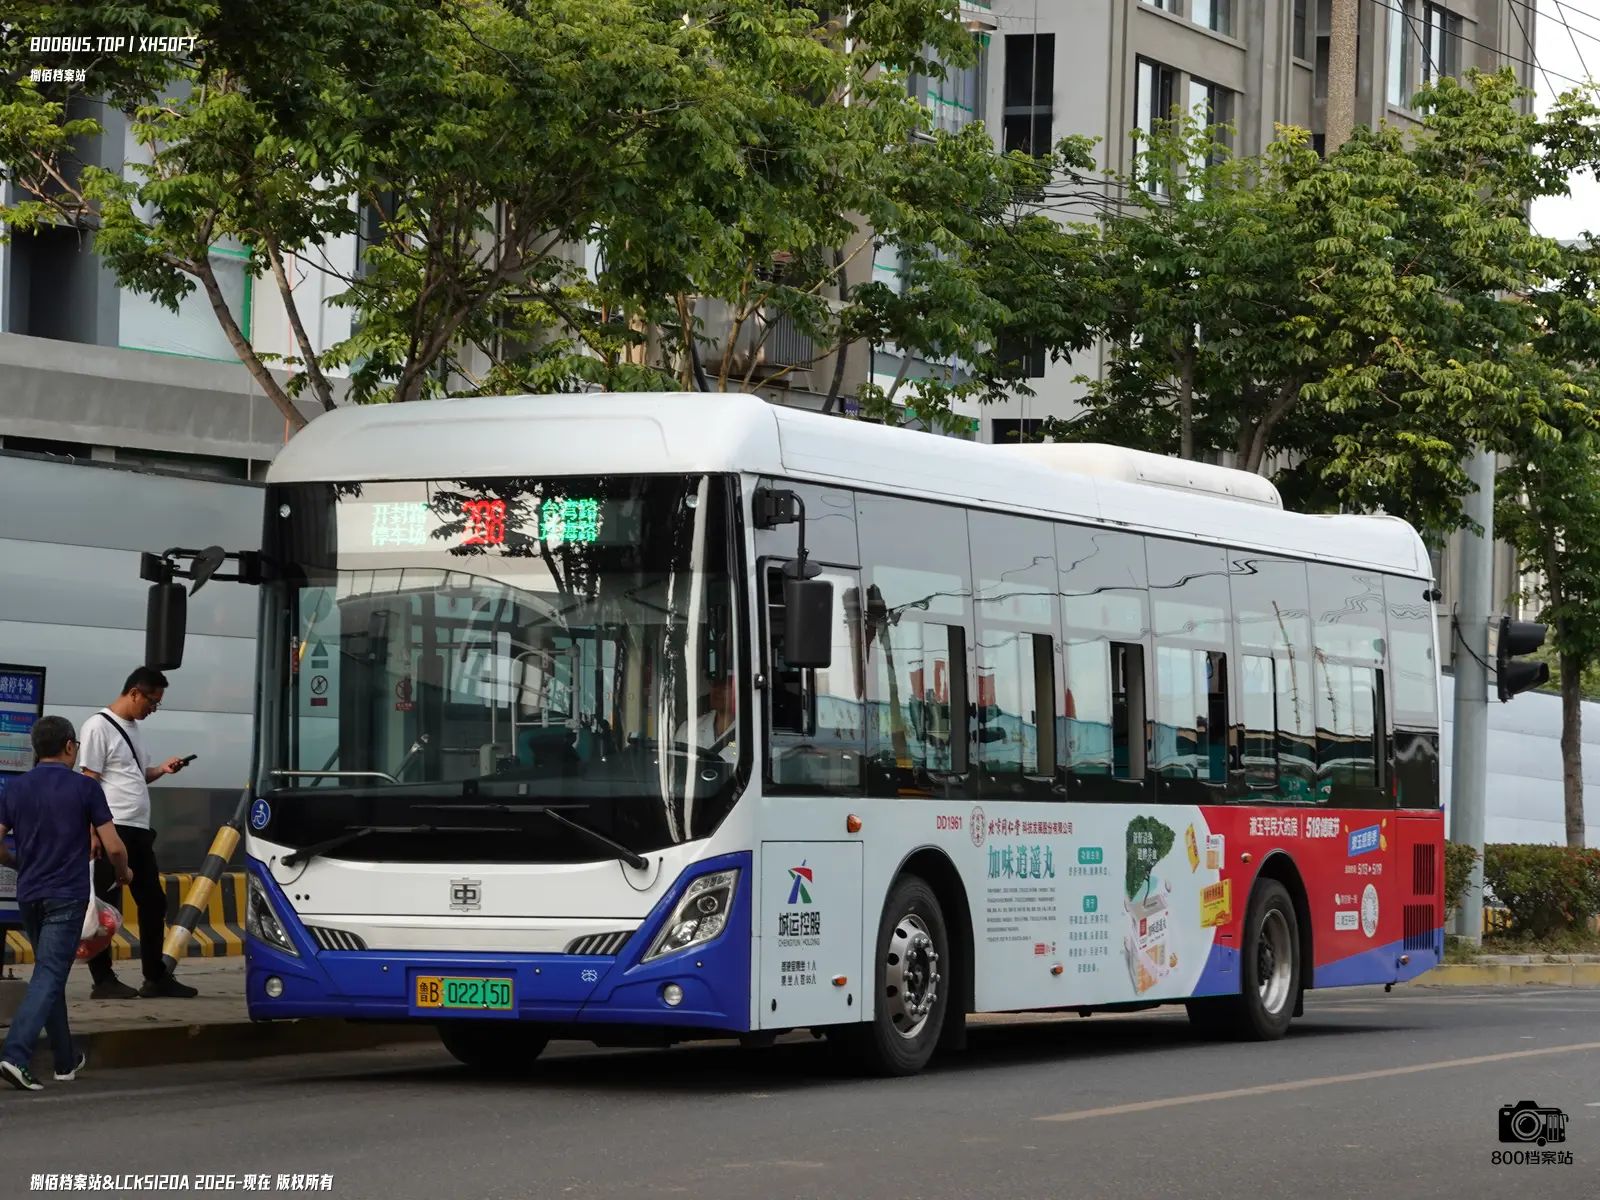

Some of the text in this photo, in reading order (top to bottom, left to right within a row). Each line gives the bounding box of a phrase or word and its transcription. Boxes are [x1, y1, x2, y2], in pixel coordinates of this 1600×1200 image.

[372, 524, 427, 546] 停车场
[936, 815, 963, 830] DD1961
[987, 844, 1055, 880] 加味逍遥丸
[778, 912, 820, 937] 城运控股
[447, 982, 510, 1005] 02215D
